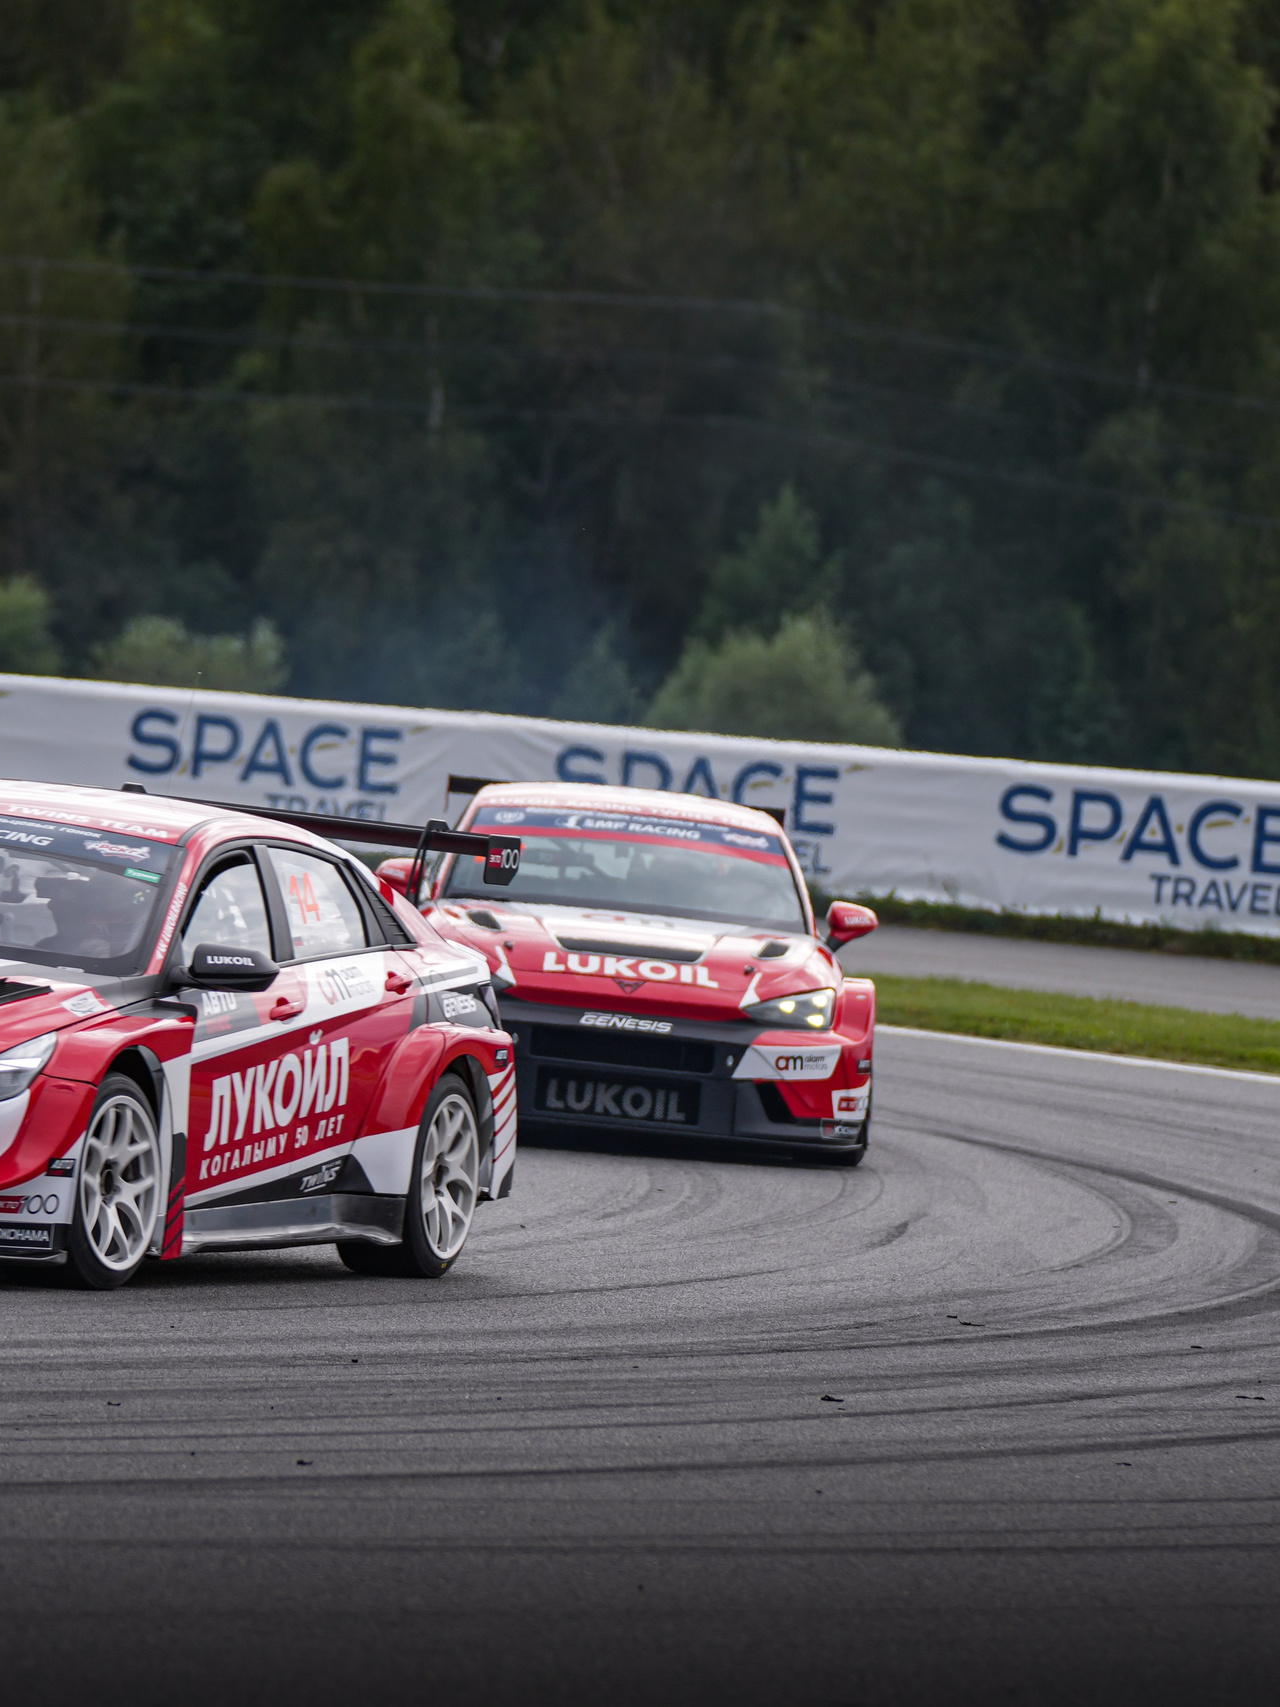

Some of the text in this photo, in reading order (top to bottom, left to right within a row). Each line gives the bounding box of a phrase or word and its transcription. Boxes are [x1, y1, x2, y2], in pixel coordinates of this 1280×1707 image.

[127, 708, 402, 794] SPACE
[2, 804, 97, 823] TWINS
[99, 818, 169, 839] TEAM
[57, 826, 103, 839] гонок
[627, 820, 702, 841] RACING
[501, 848, 520, 870] 100
[289, 871, 322, 925] 14
[1149, 872, 1280, 915] TRAVE
[205, 954, 255, 967] LUKOIL
[542, 951, 719, 989] LUKOIL
[578, 1013, 674, 1034] GENESIS
[775, 1055, 804, 1071] am
[203, 1029, 350, 1152] ЛУКОЙЛ
[545, 1077, 687, 1122] LUKOIL
[198, 1114, 346, 1181] КОГАЛЫМУ 50 ЛЕТ
[18, 1194, 60, 1215] 100
